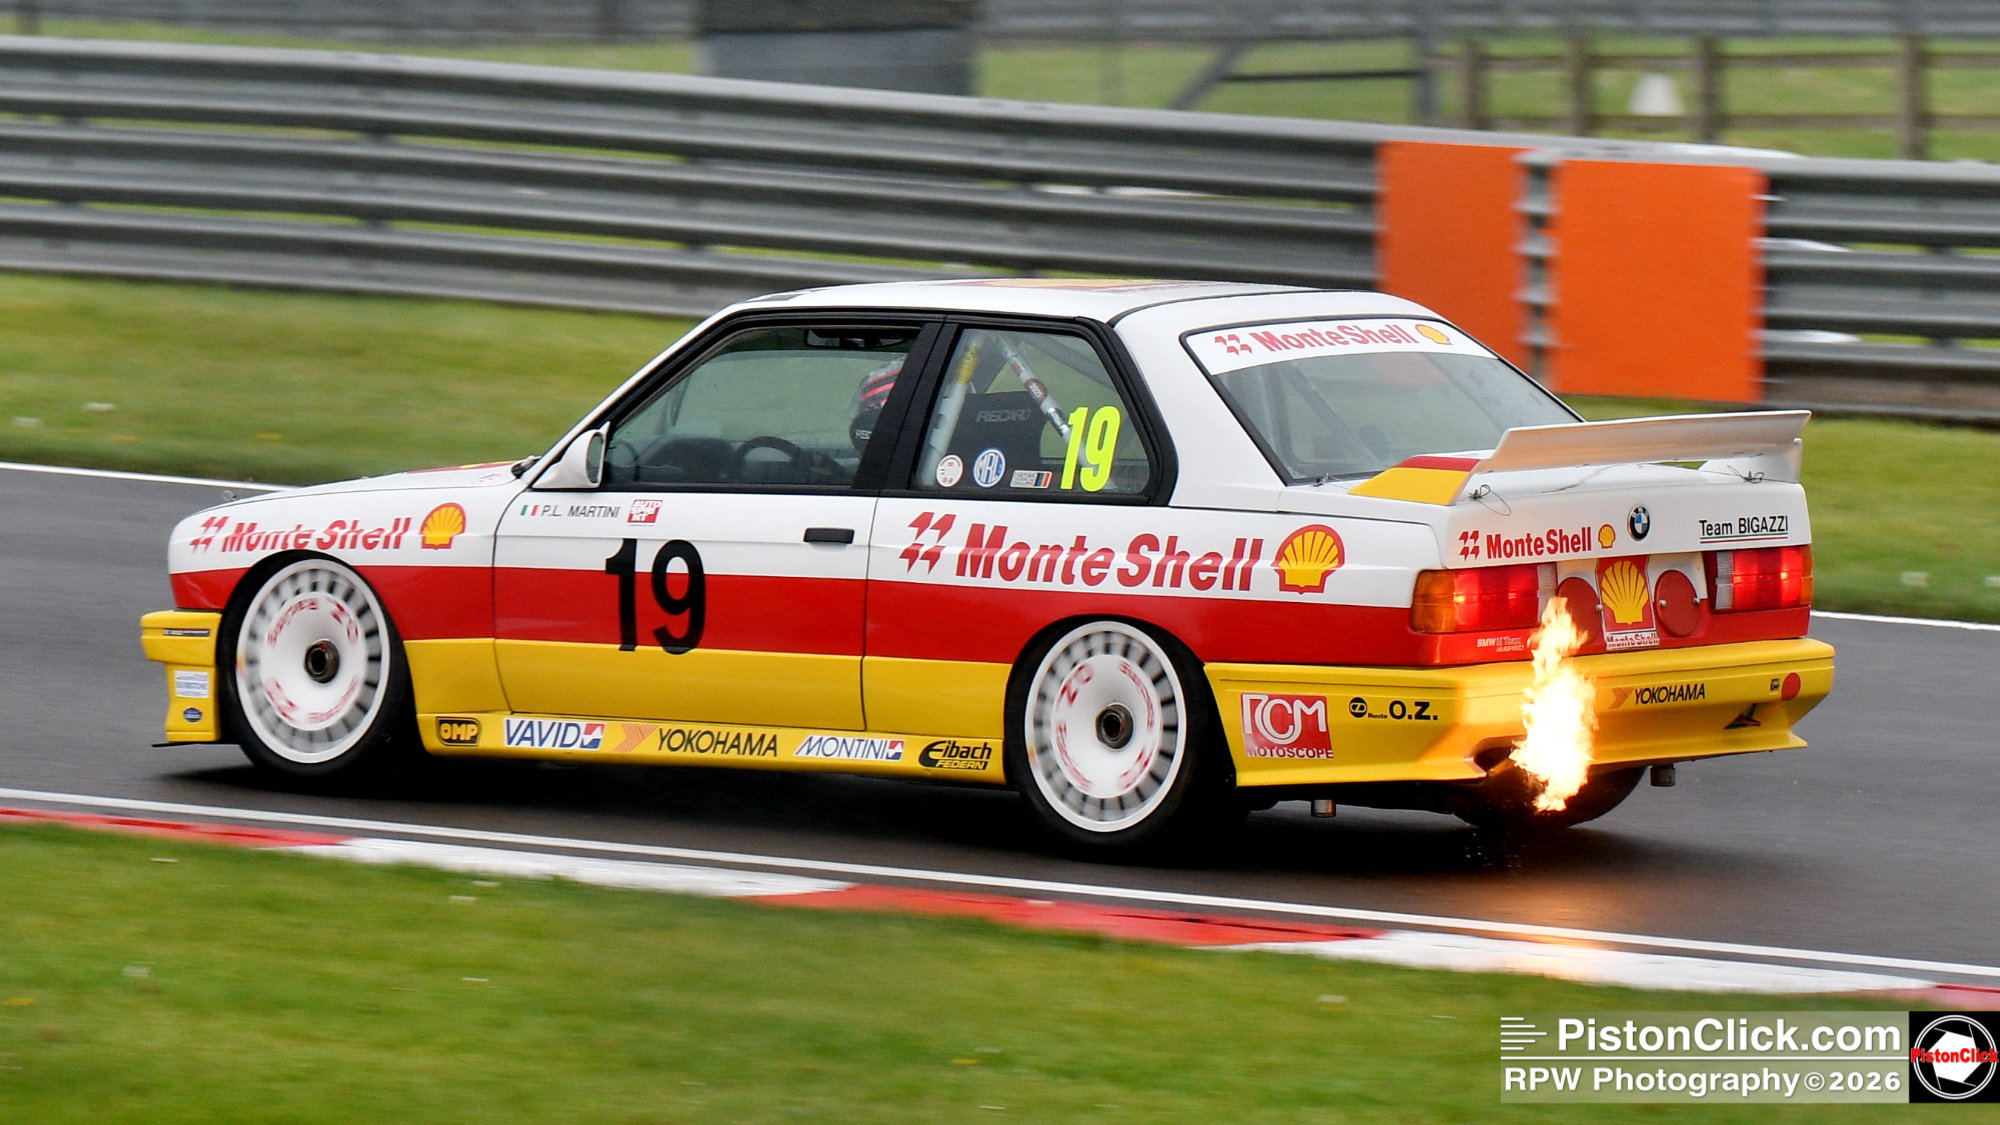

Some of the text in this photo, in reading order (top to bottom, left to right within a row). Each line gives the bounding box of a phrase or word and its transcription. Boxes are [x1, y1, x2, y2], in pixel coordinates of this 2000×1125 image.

[1060, 406, 1121, 492] 19
[567, 505, 621, 518] MARTINI
[1699, 515, 1788, 536] Team BIGAZZI
[605, 538, 706, 655] 19
[1633, 682, 1706, 705] YOKOHAMA
[1389, 700, 1438, 721] O.Z.
[440, 722, 479, 741] OMP
[505, 719, 581, 748] VAVID
[657, 728, 778, 757] YOKOHAMA
[795, 735, 888, 760] MONTINI
[918, 739, 993, 768] Eibach
[935, 759, 986, 770] FEDERN
